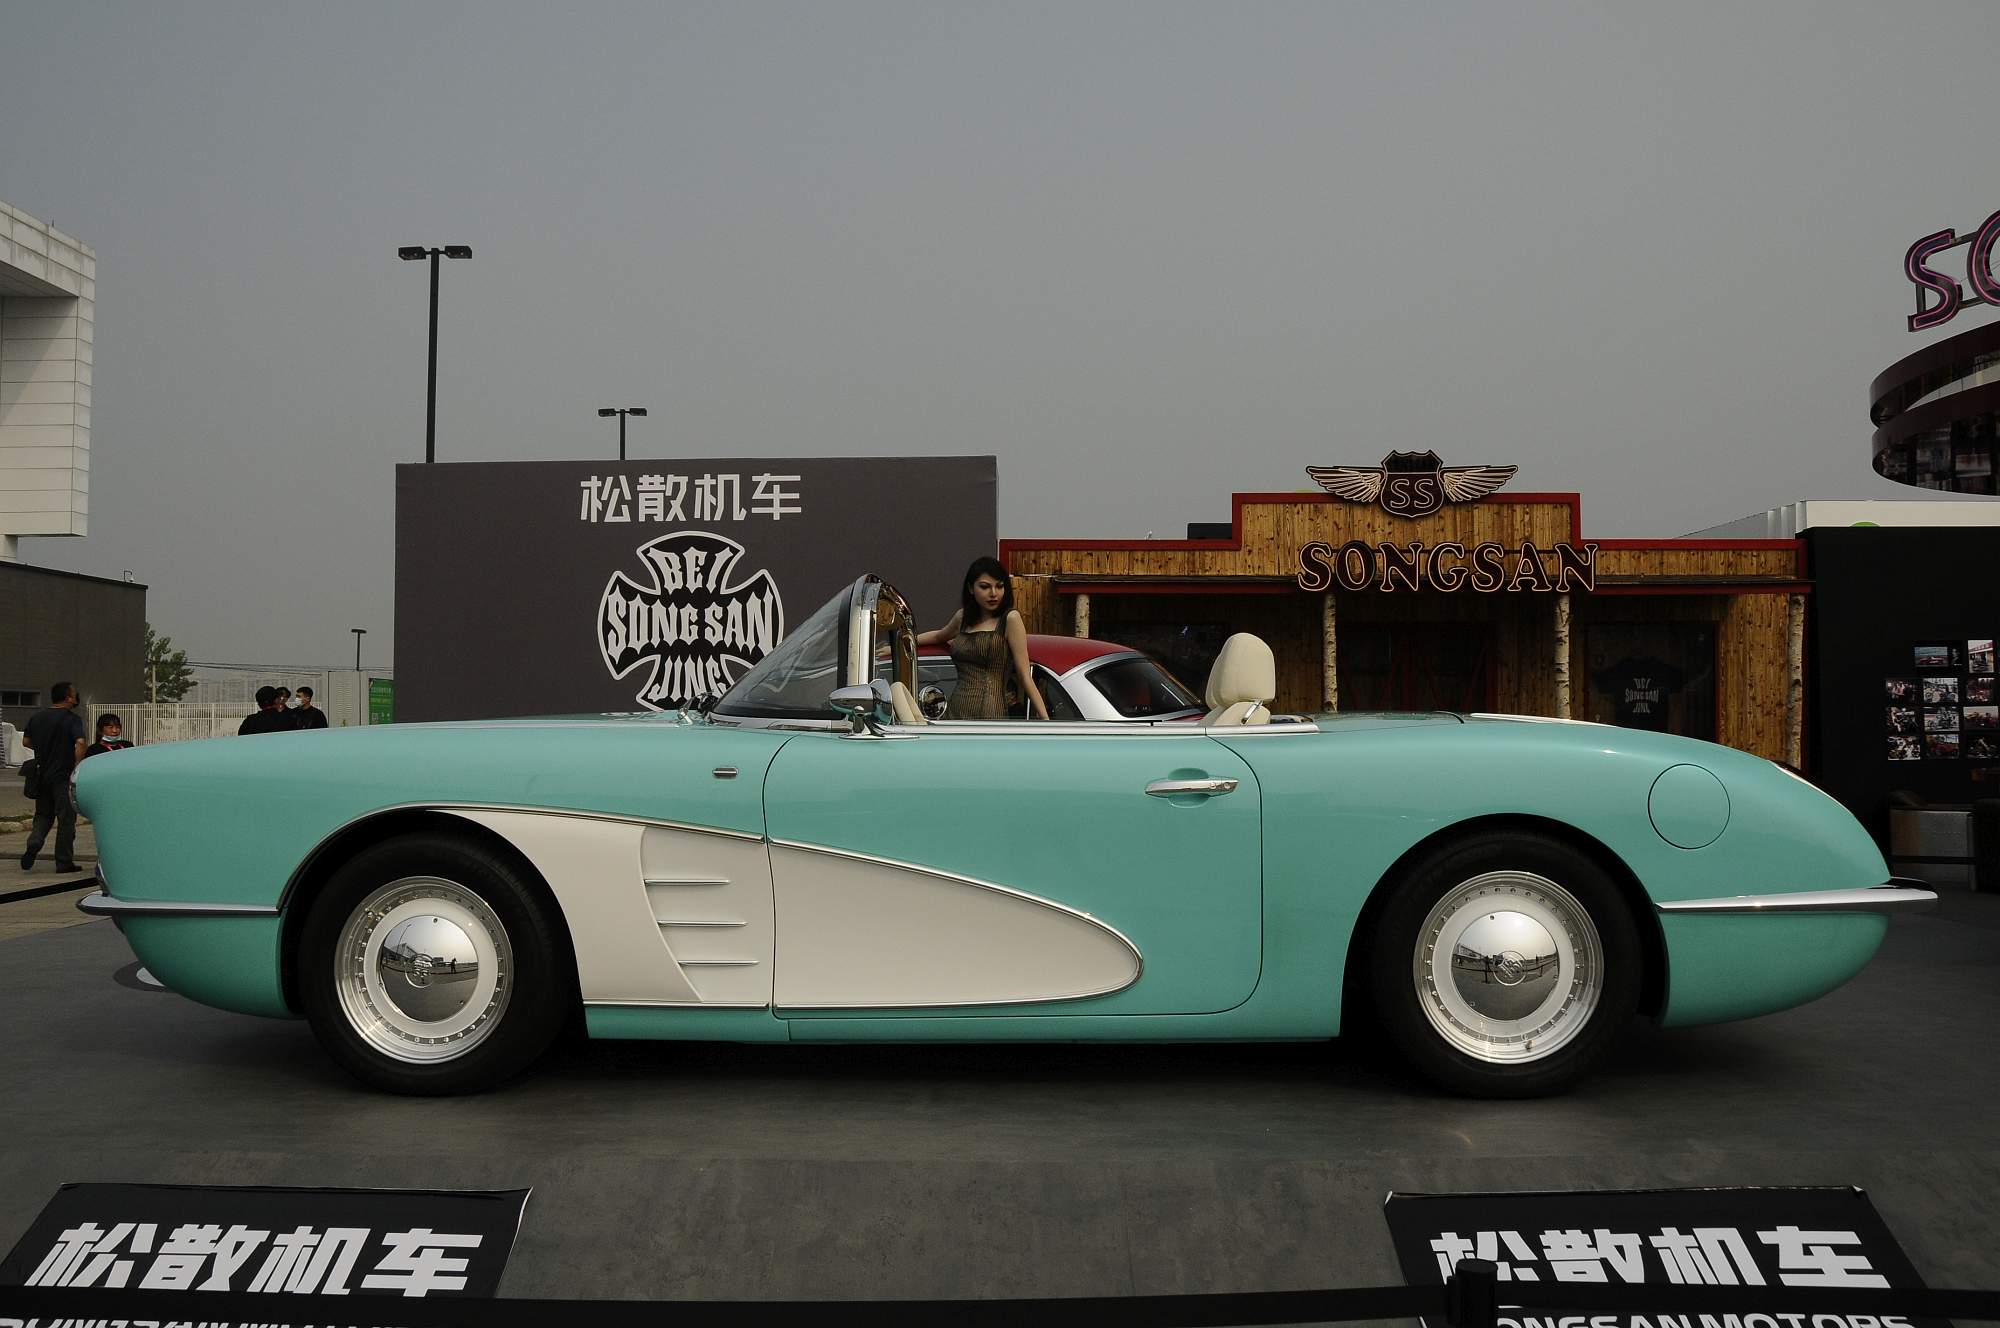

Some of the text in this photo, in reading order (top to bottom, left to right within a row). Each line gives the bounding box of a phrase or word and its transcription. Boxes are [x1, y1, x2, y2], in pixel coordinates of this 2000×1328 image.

[580, 473, 802, 523] 松散机车
[1390, 478, 1434, 509] SS
[647, 546, 733, 595] BEI
[1298, 540, 1598, 593] SONGSAN
[647, 654, 727, 702] JING
[24, 1223, 484, 1298] 松散机车
[1429, 1225, 1891, 1289] 松散机车
